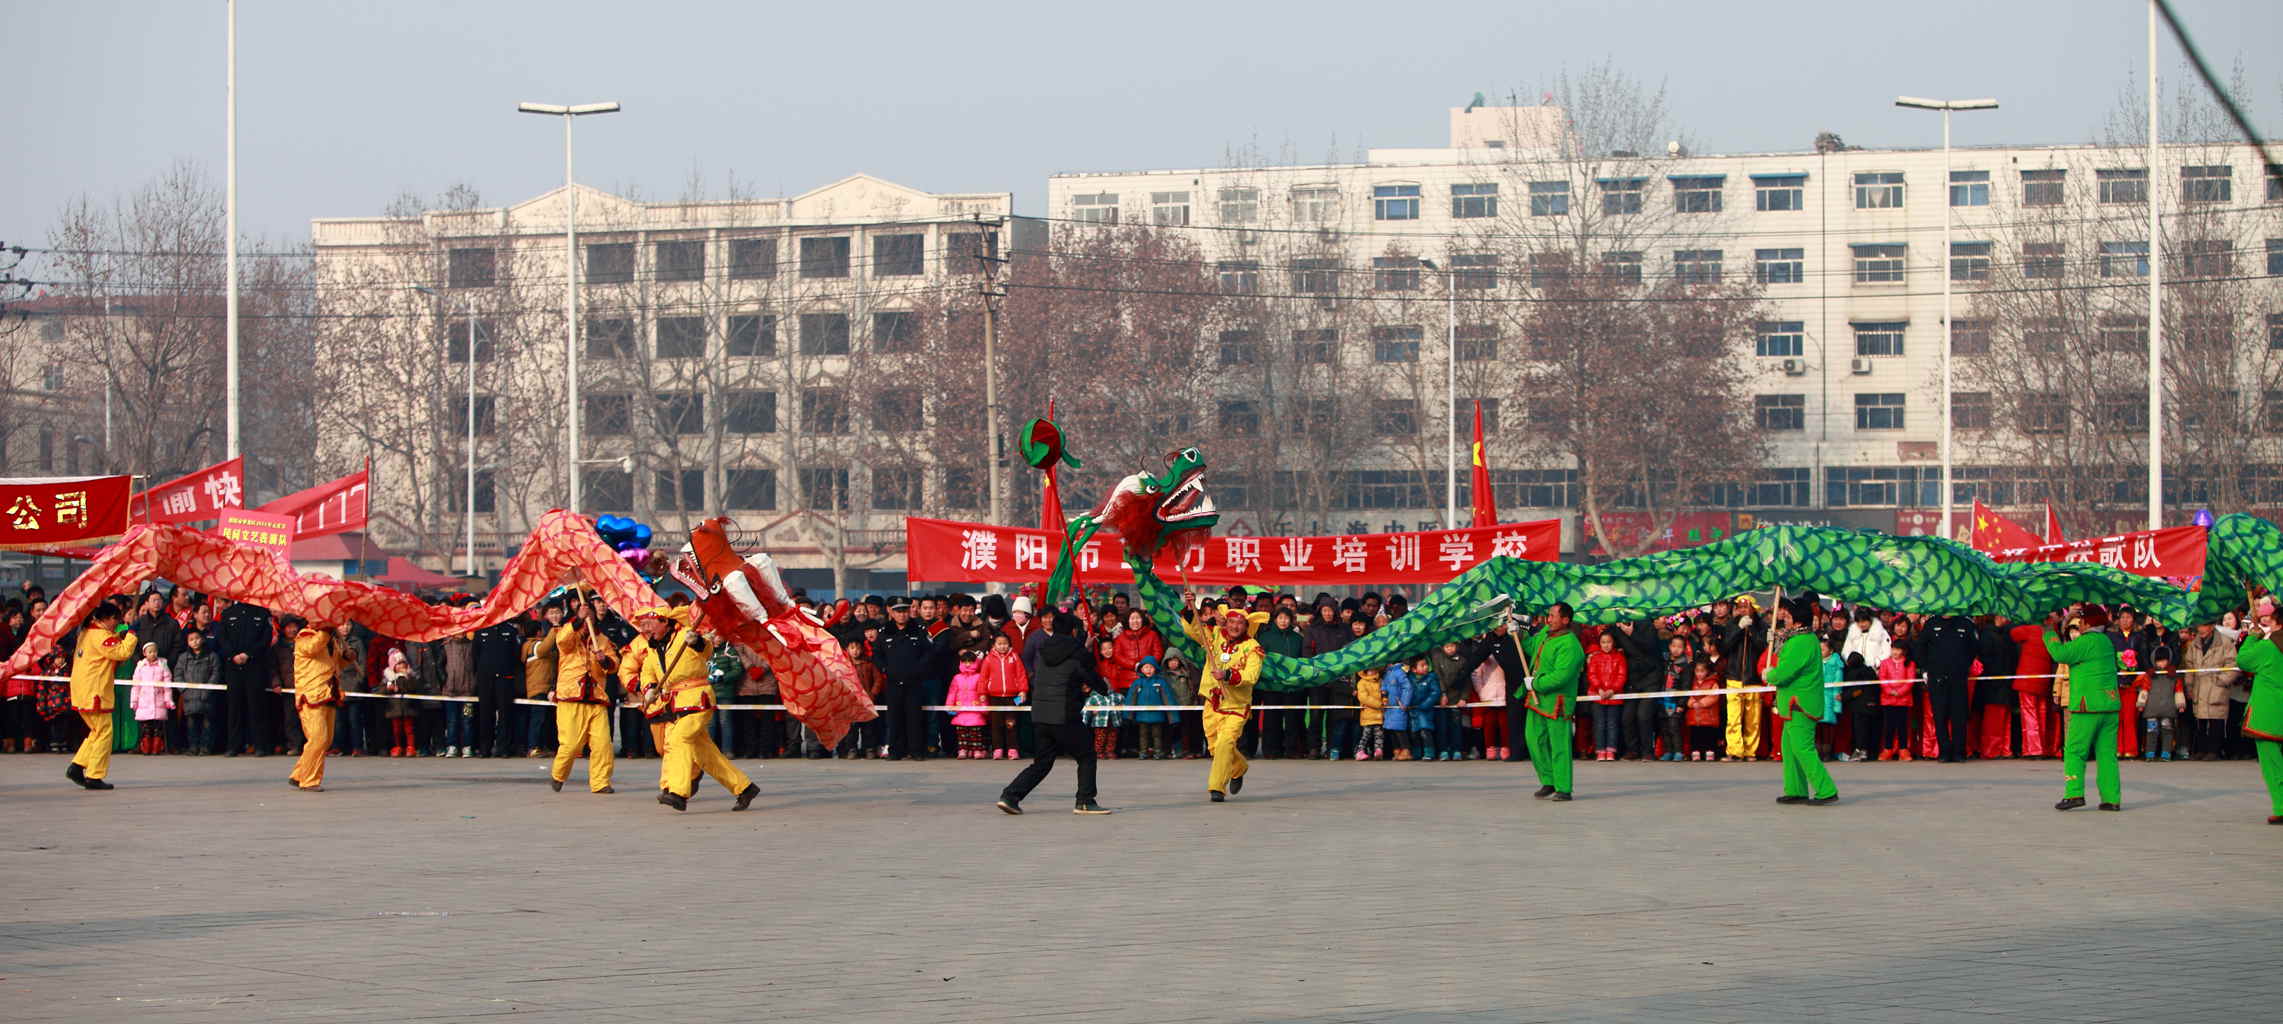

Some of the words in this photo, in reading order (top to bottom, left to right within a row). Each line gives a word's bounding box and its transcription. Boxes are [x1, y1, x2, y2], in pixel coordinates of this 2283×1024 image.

[5, 491, 88, 529] 公司
[961, 529, 1527, 573] 濮阳市方职业培训学校
